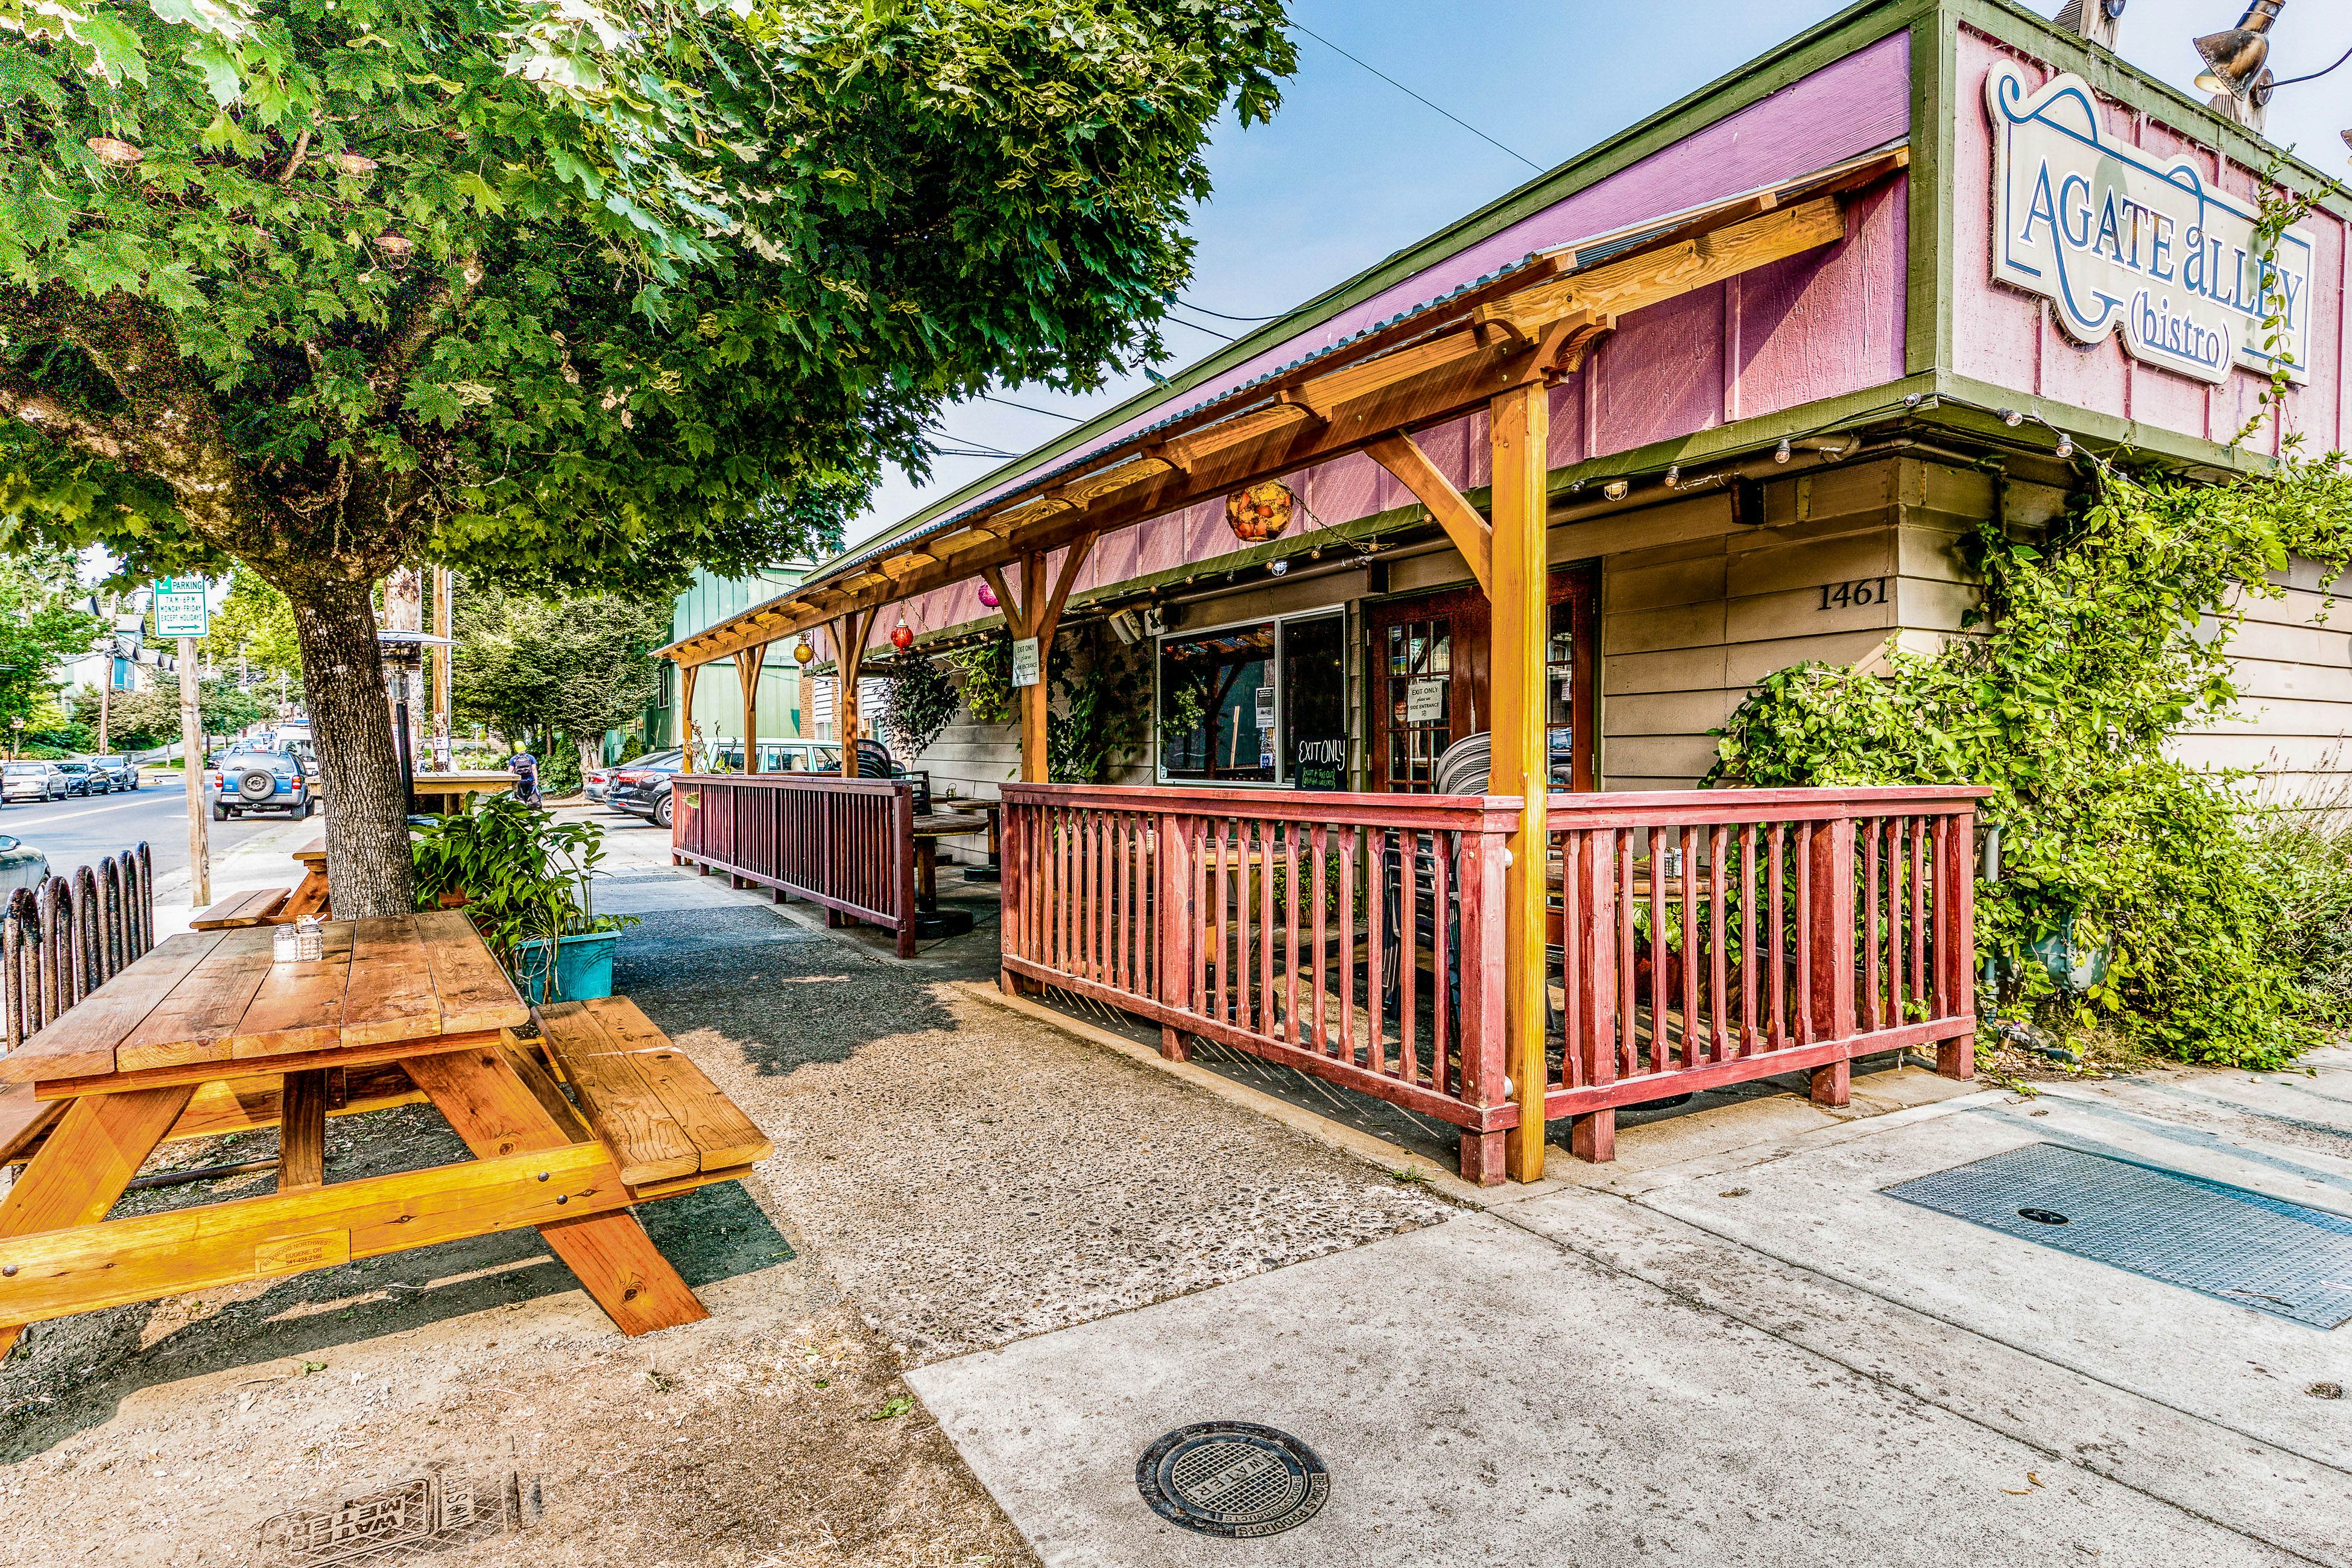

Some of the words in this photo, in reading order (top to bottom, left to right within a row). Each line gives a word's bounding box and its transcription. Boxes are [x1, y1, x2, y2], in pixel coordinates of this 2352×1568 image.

[2020, 159, 2176, 327] AGATE
[2131, 290, 2231, 372] (bistro)
[172, 581, 202, 590] PARKING
[1817, 578, 1889, 611] 1461
[1298, 740, 1321, 763] EXIT
[262, 1245, 292, 1266] REDWOOD
[293, 1240, 333, 1248] NORTHWEST
[1195, 1459, 1264, 1497] WATER
[1284, 1476, 1301, 1505] BROOKS
[1304, 1475, 1325, 1509] BROOKS
[292, 1498, 402, 1538] METER
[1225, 1505, 1284, 1522] PRODUCTS
[1238, 1510, 1309, 1535] PRODUCTS
[285, 1514, 397, 1553] WATER
